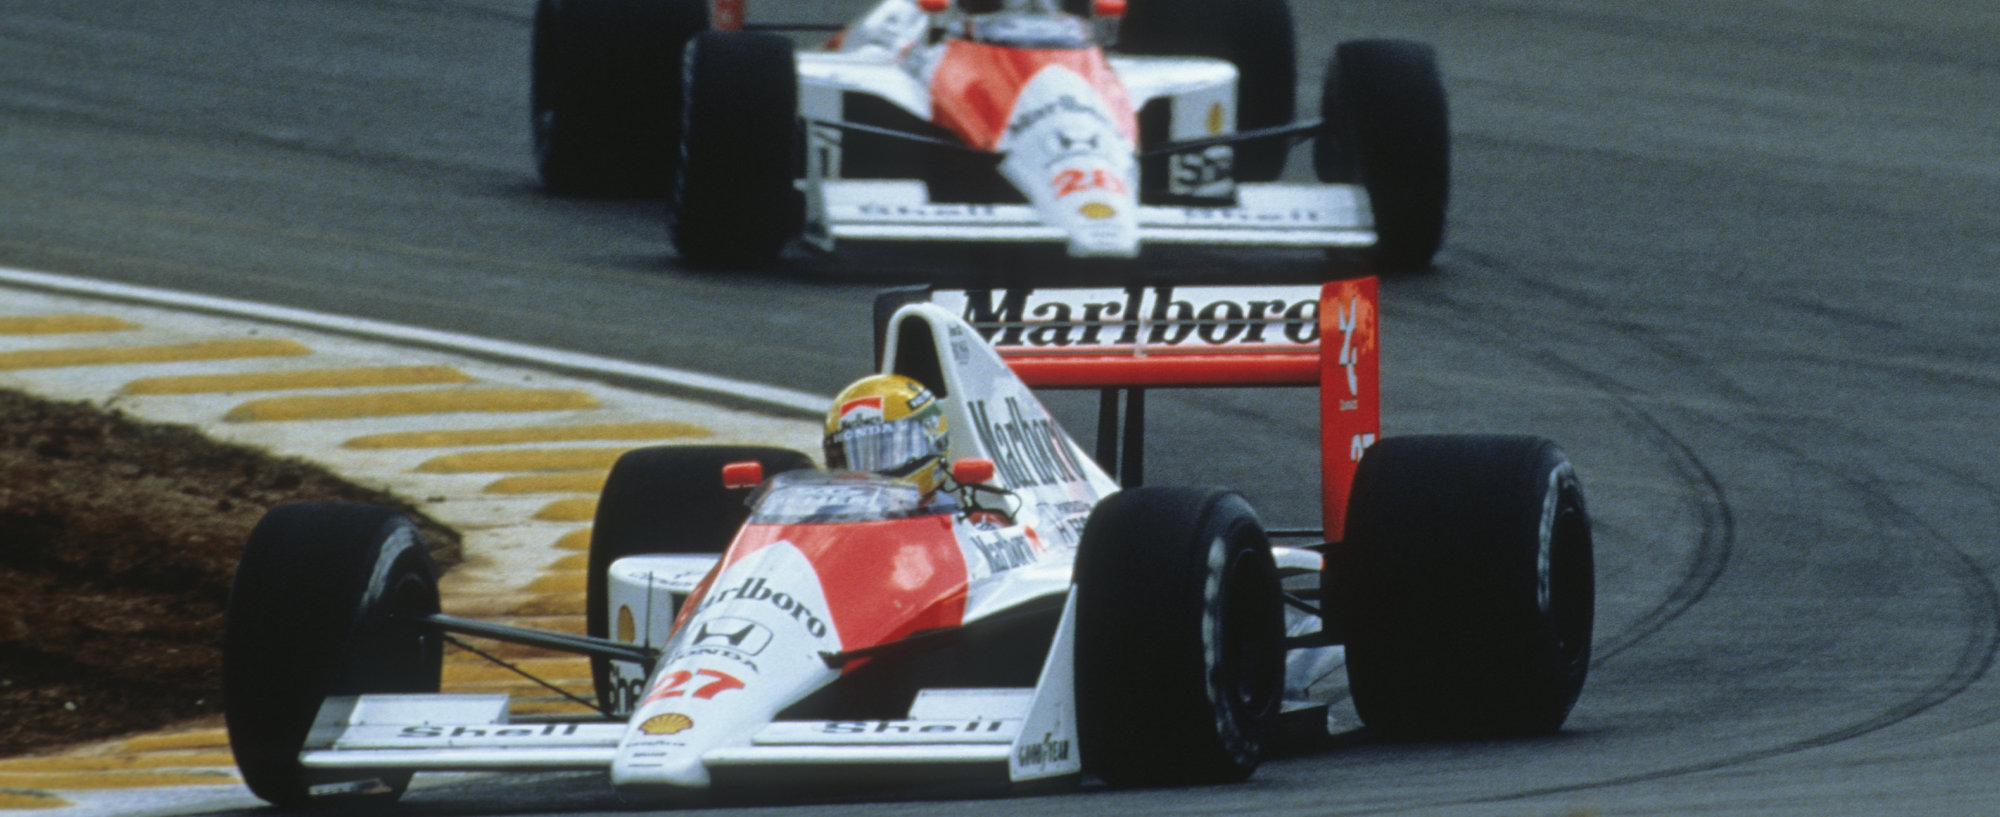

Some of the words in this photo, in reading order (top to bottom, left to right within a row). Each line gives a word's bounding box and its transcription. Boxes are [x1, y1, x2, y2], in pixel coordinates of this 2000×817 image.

[963, 286, 1320, 346] Marlboro
[967, 396, 1087, 491] Marlboro
[640, 668, 746, 706] 27
[399, 725, 578, 738] Shell
[818, 720, 1002, 734] Shell
